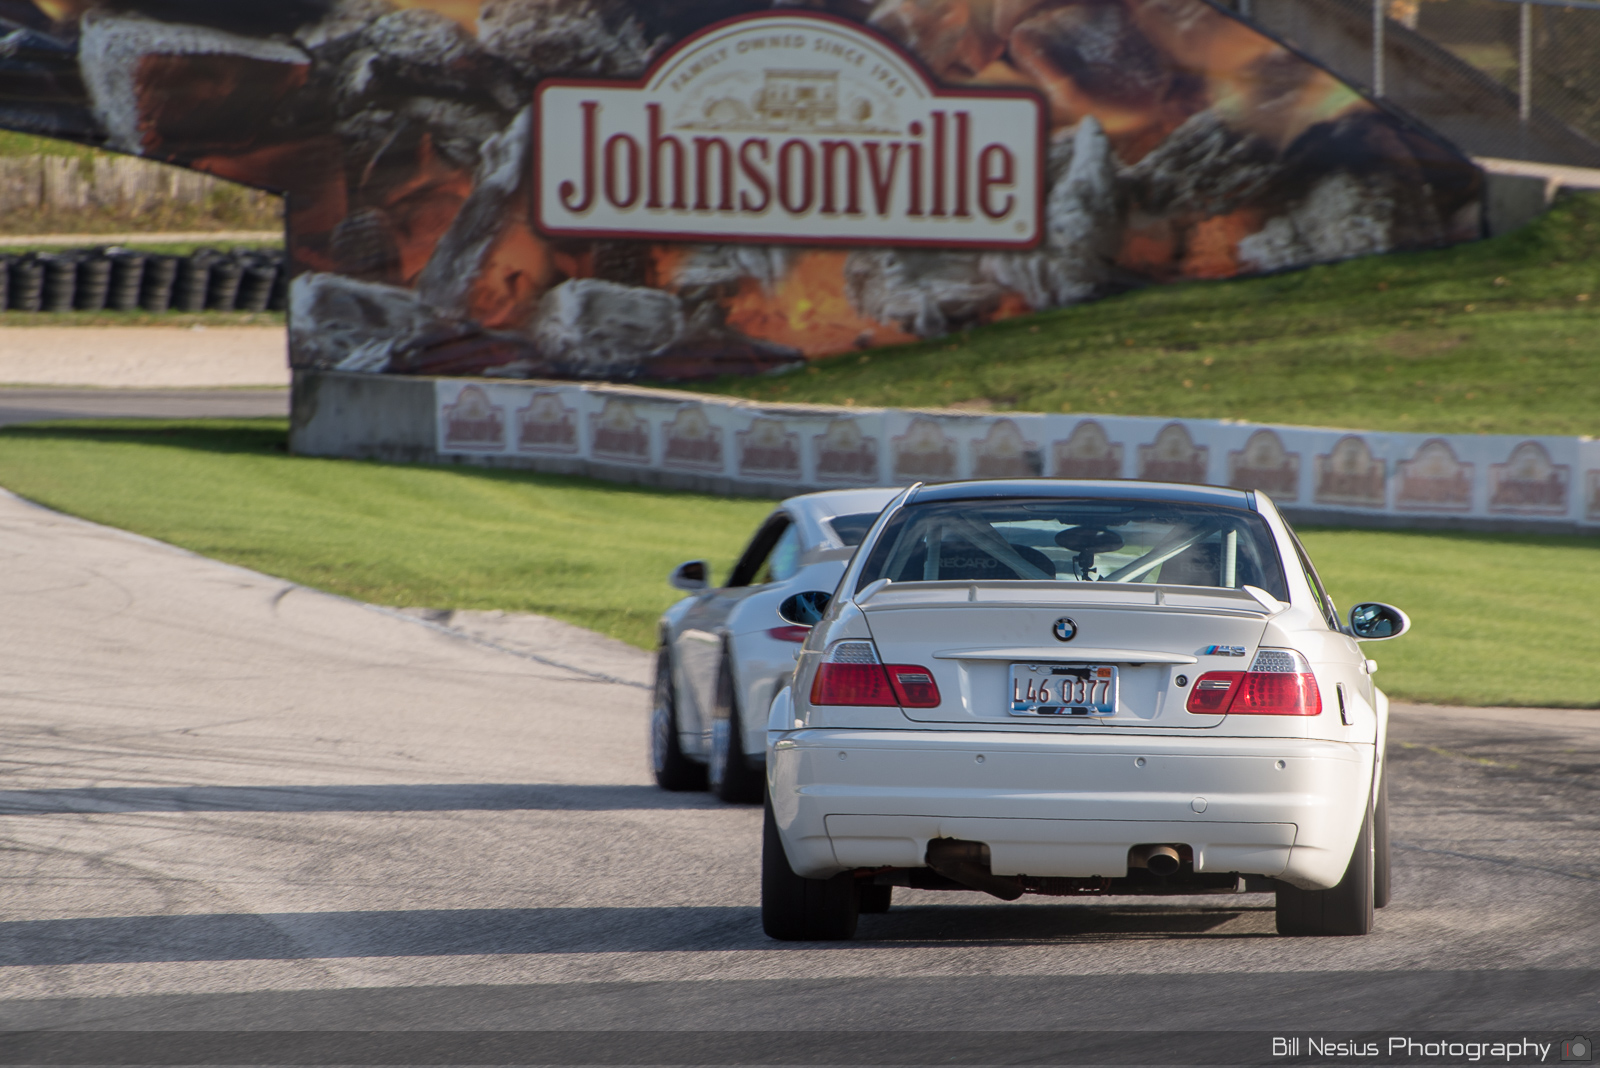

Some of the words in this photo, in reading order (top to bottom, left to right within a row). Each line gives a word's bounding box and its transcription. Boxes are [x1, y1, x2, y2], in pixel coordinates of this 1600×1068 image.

[670, 46, 730, 92] FAMILY
[736, 34, 807, 55] OWNED
[813, 36, 867, 68] SINCE
[870, 63, 908, 98] 1945
[558, 100, 1015, 220] Johnsonville
[1014, 678, 1051, 703] L46
[1062, 679, 1110, 705] 0377
